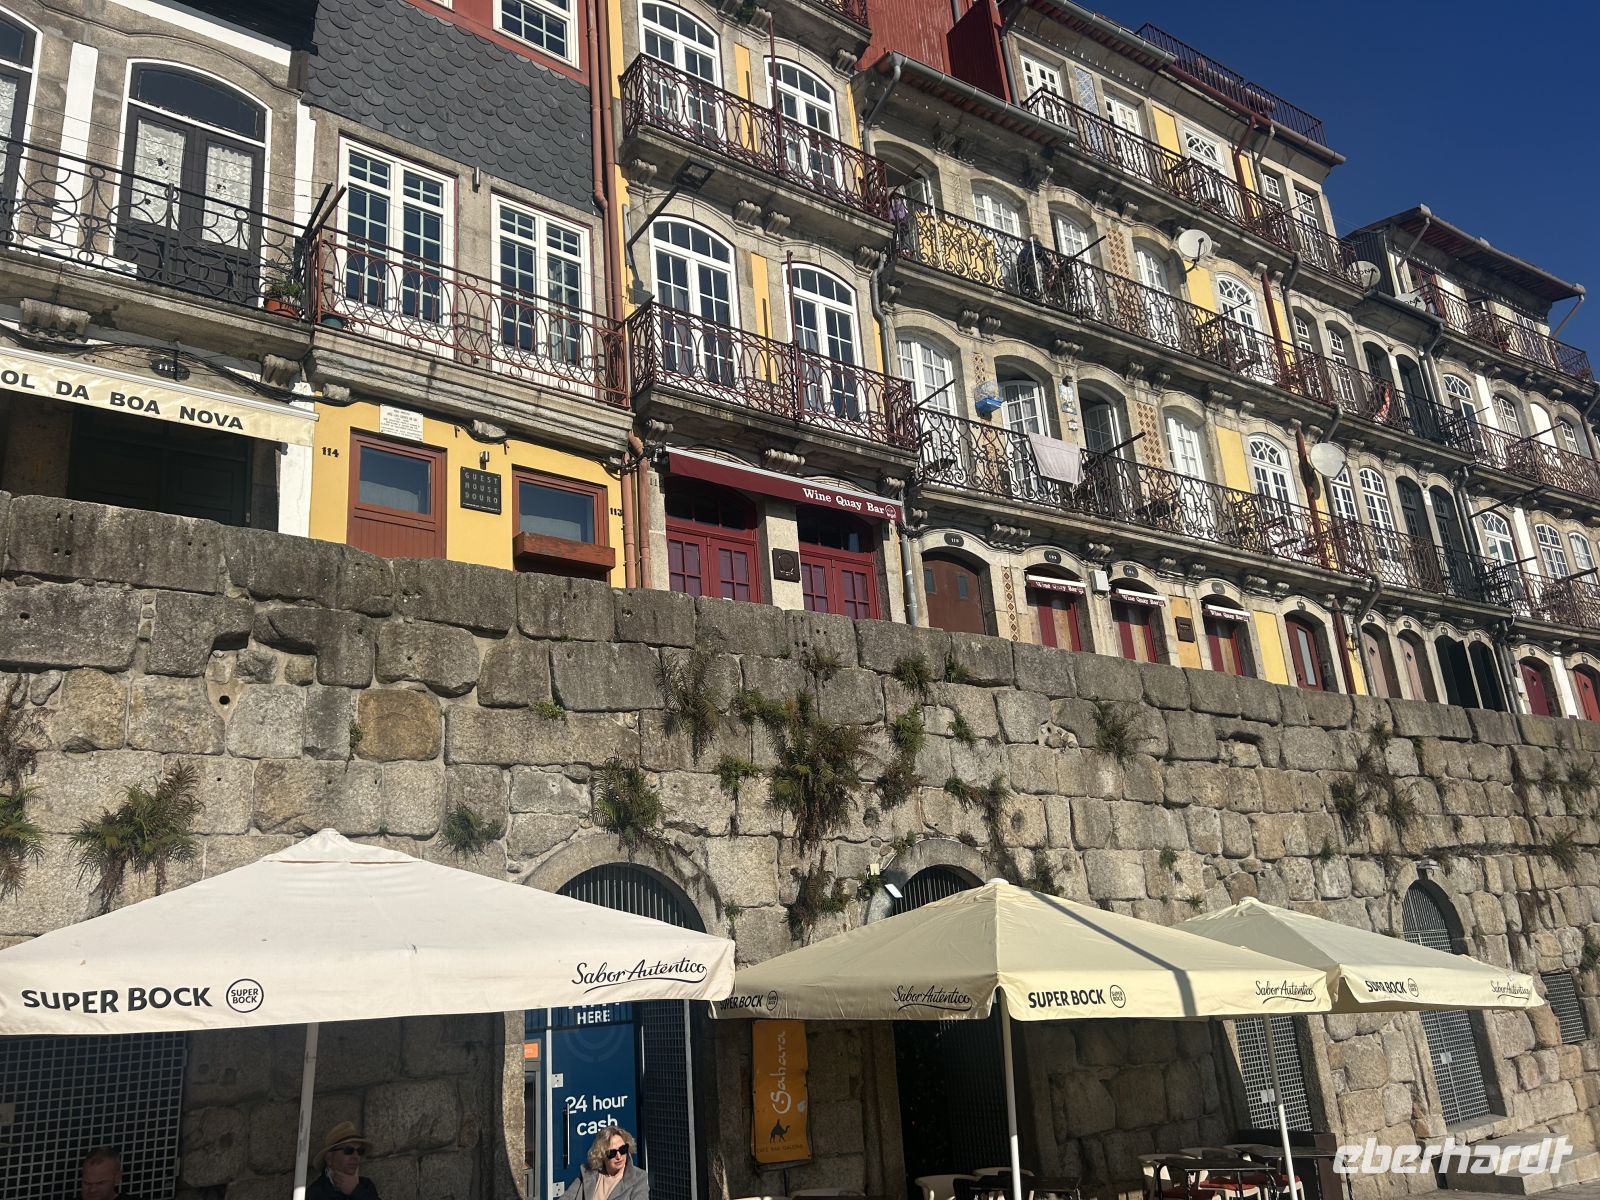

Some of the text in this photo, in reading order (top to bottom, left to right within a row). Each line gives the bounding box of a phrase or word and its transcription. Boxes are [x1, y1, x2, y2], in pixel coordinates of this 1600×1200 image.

[1, 370, 244, 430] OL DA BOA NOVA
[321, 446, 340, 458] 114
[464, 472, 498, 485] GUEST
[464, 482, 498, 494] HOUSE
[464, 491, 498, 504] DOURO
[802, 487, 832, 503] Wine
[835, 495, 862, 511] Quay
[866, 501, 885, 514] Bar
[571, 961, 627, 985] Sabor
[231, 988, 259, 997] SUPER
[893, 984, 922, 1003] Sabor
[1255, 980, 1280, 996] Sabor
[1384, 981, 1407, 993] BOCK
[21, 986, 213, 1014] SUPER BOCK
[232, 995, 258, 1004] BOCK
[739, 994, 764, 1009] BOCK
[1027, 988, 1107, 1009] SUPER BOCK
[576, 1009, 611, 1025] HERE
[769, 1031, 793, 1115] Sahara
[564, 1094, 629, 1115] 24 hour
[576, 1113, 618, 1136] cash
